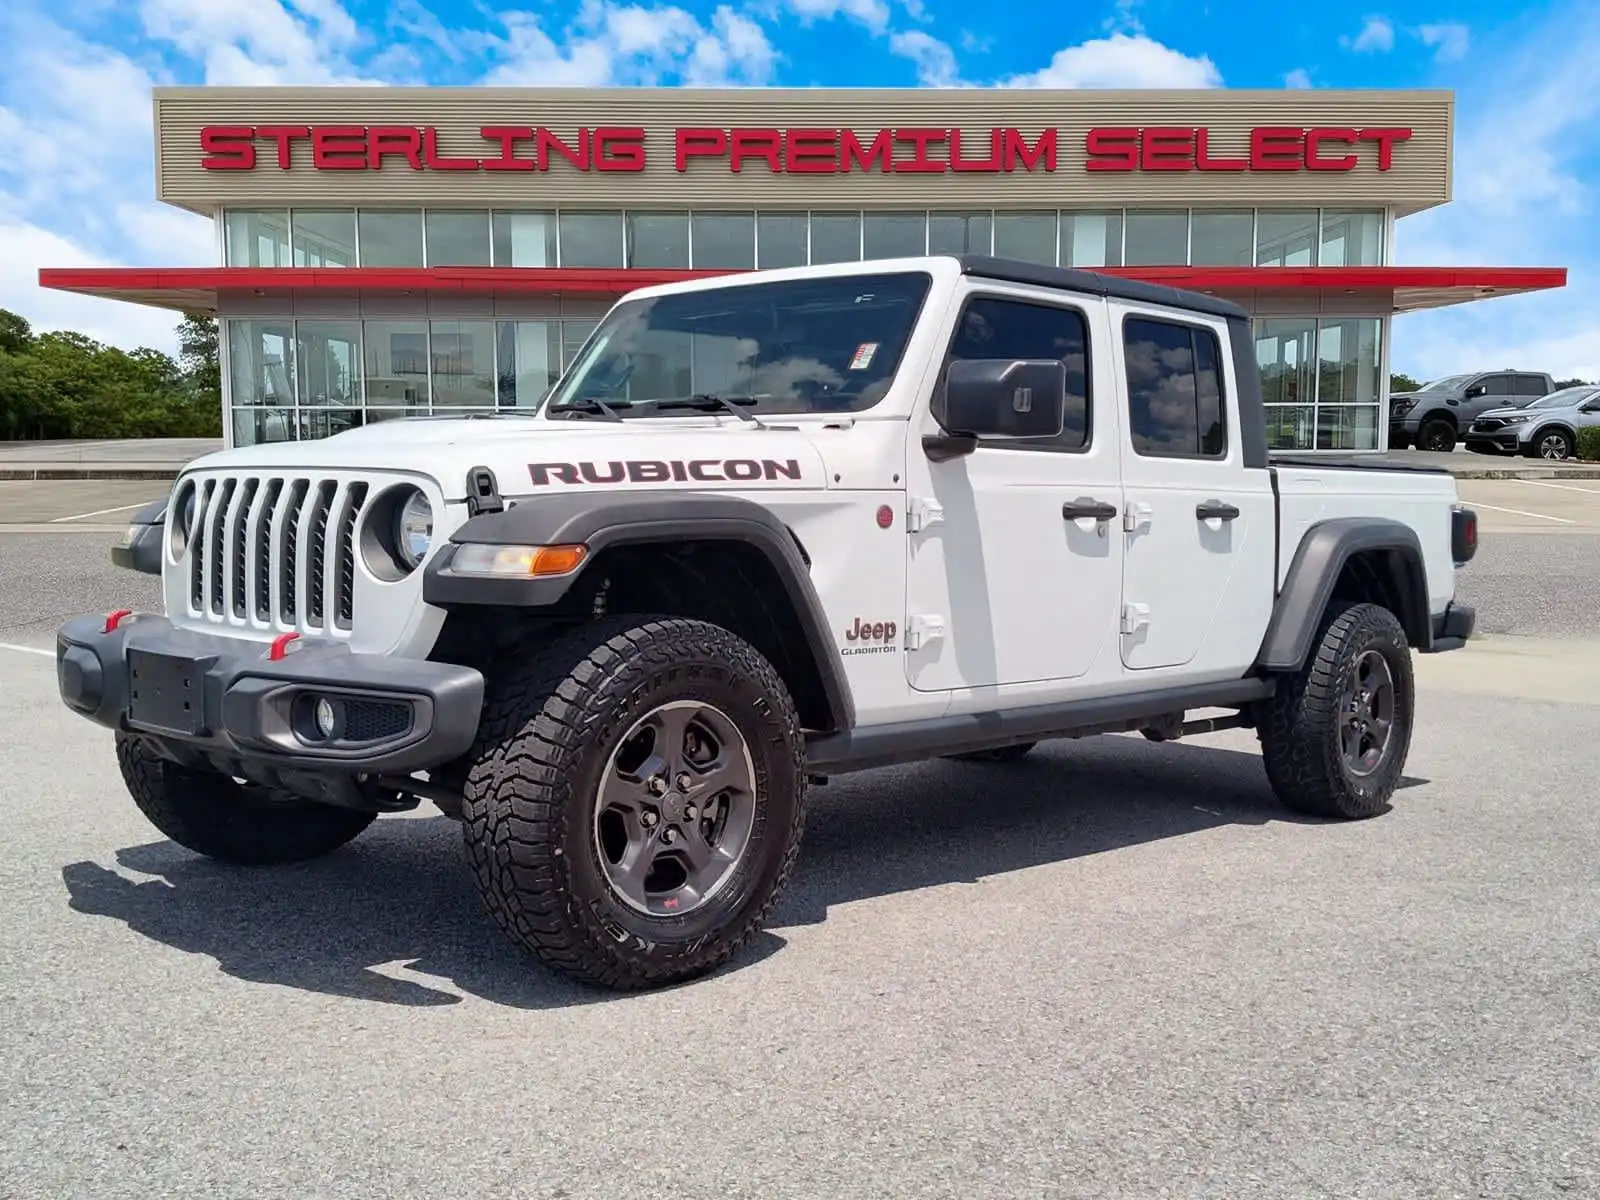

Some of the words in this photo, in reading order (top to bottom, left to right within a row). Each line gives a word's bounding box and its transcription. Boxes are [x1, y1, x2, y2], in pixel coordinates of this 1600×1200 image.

[200, 125, 646, 172] STERLING
[674, 128, 1057, 173] PREMIUM
[1086, 127, 1413, 172] SELECT
[528, 459, 802, 486] RUBICON
[846, 617, 897, 643] Jeep
[841, 646, 897, 656] GLADIATOR
